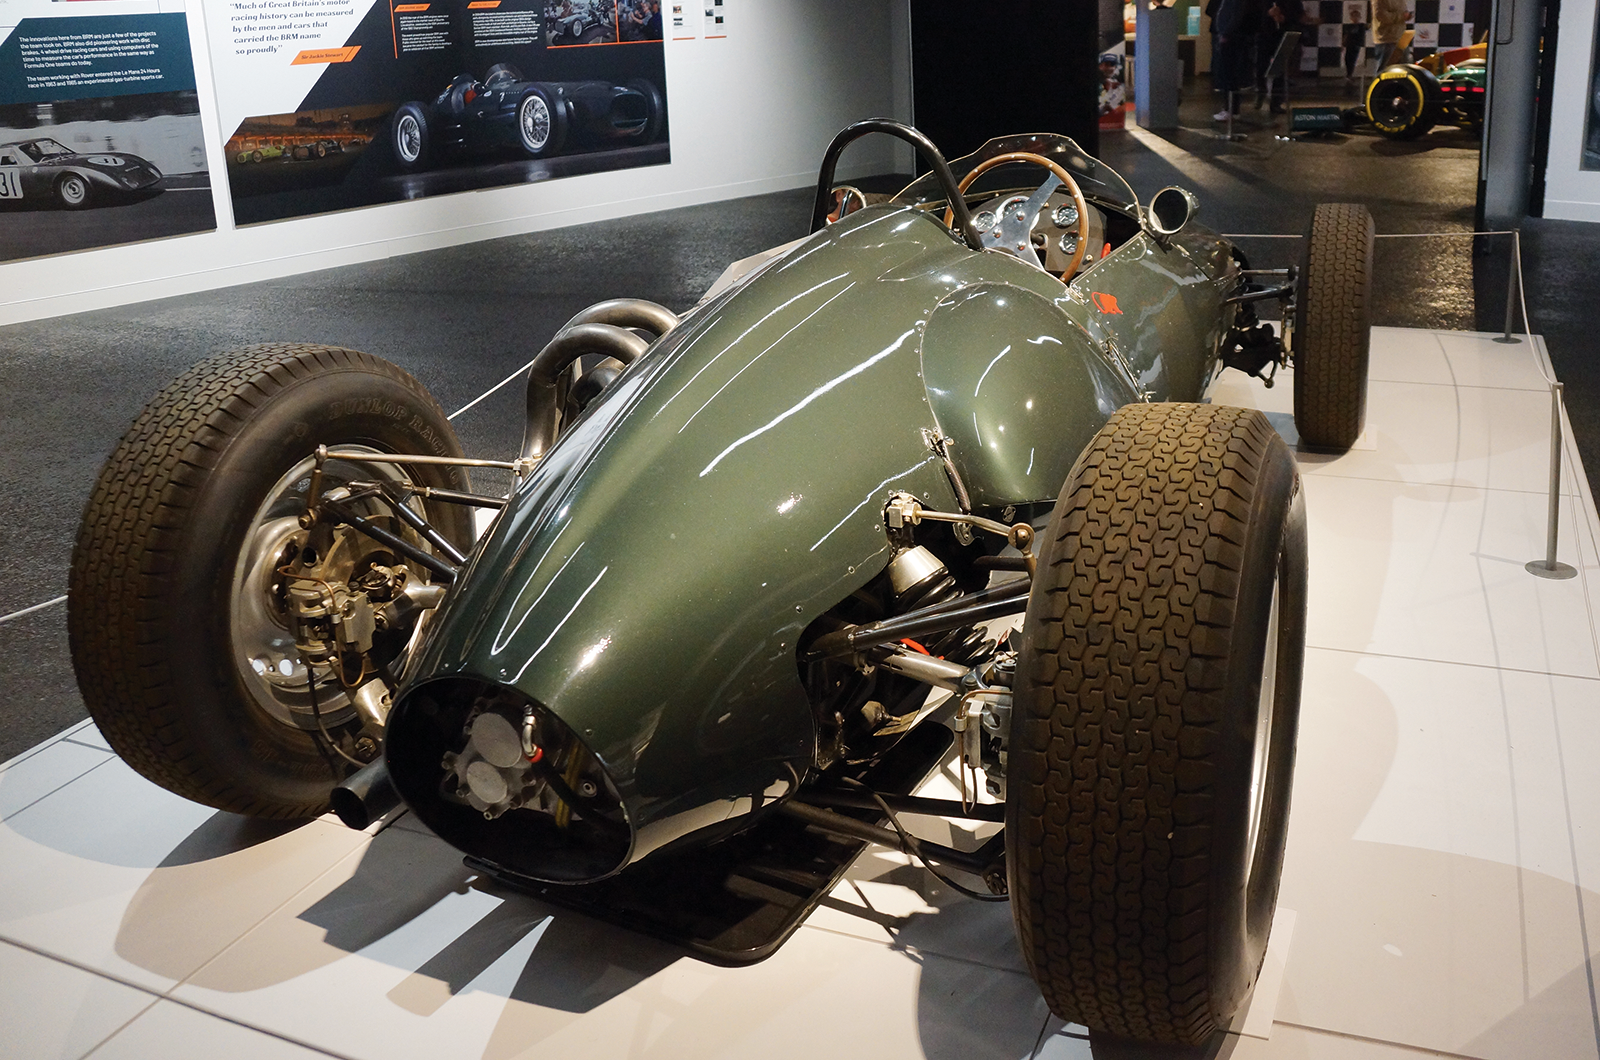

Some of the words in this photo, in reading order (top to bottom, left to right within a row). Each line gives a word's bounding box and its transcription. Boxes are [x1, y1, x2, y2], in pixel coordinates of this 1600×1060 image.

[234, 35, 264, 43] carried
[246, 44, 282, 55] proudly"
[0, 172, 17, 196] 31
[330, 398, 408, 420] DUNLOP
